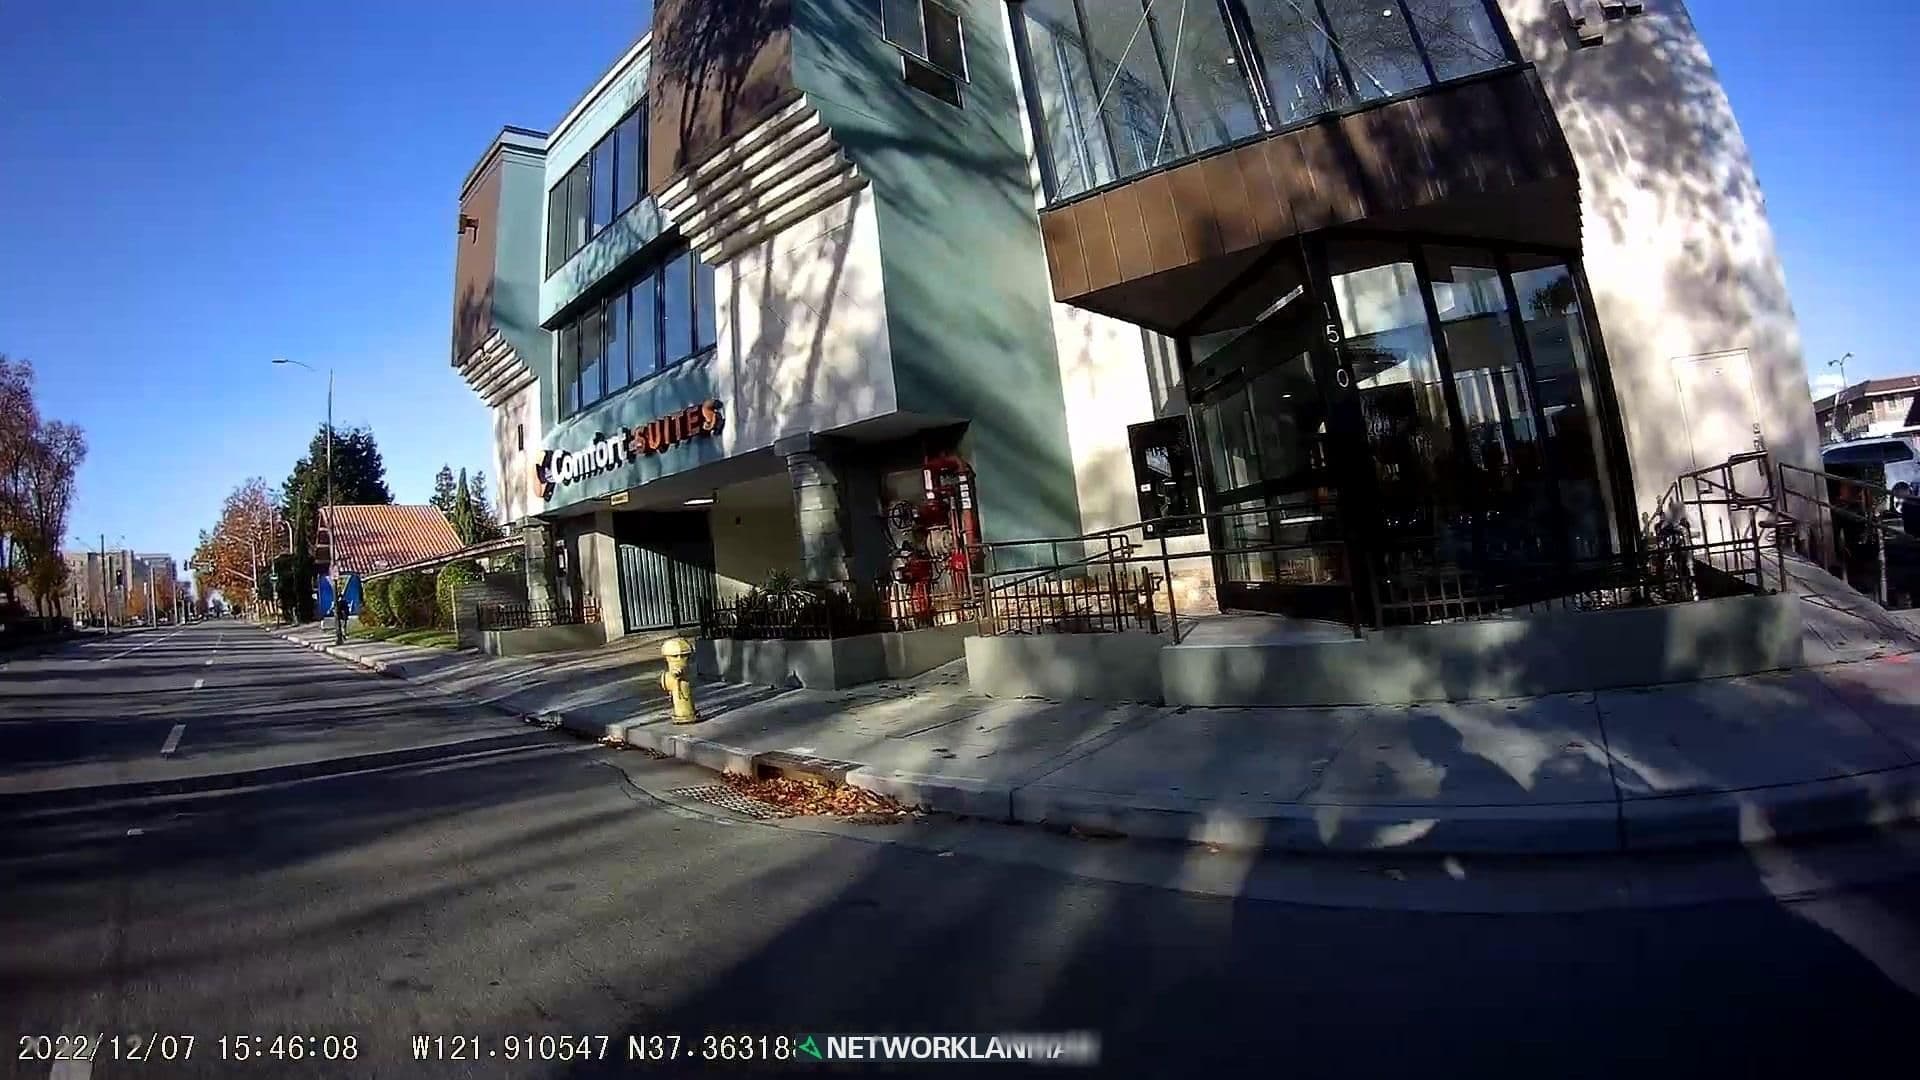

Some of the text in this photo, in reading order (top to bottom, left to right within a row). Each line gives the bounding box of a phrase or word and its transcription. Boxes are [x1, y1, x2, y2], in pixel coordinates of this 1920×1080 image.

[1322, 301, 1350, 388] 1510
[550, 401, 723, 484] Comfort SUITES
